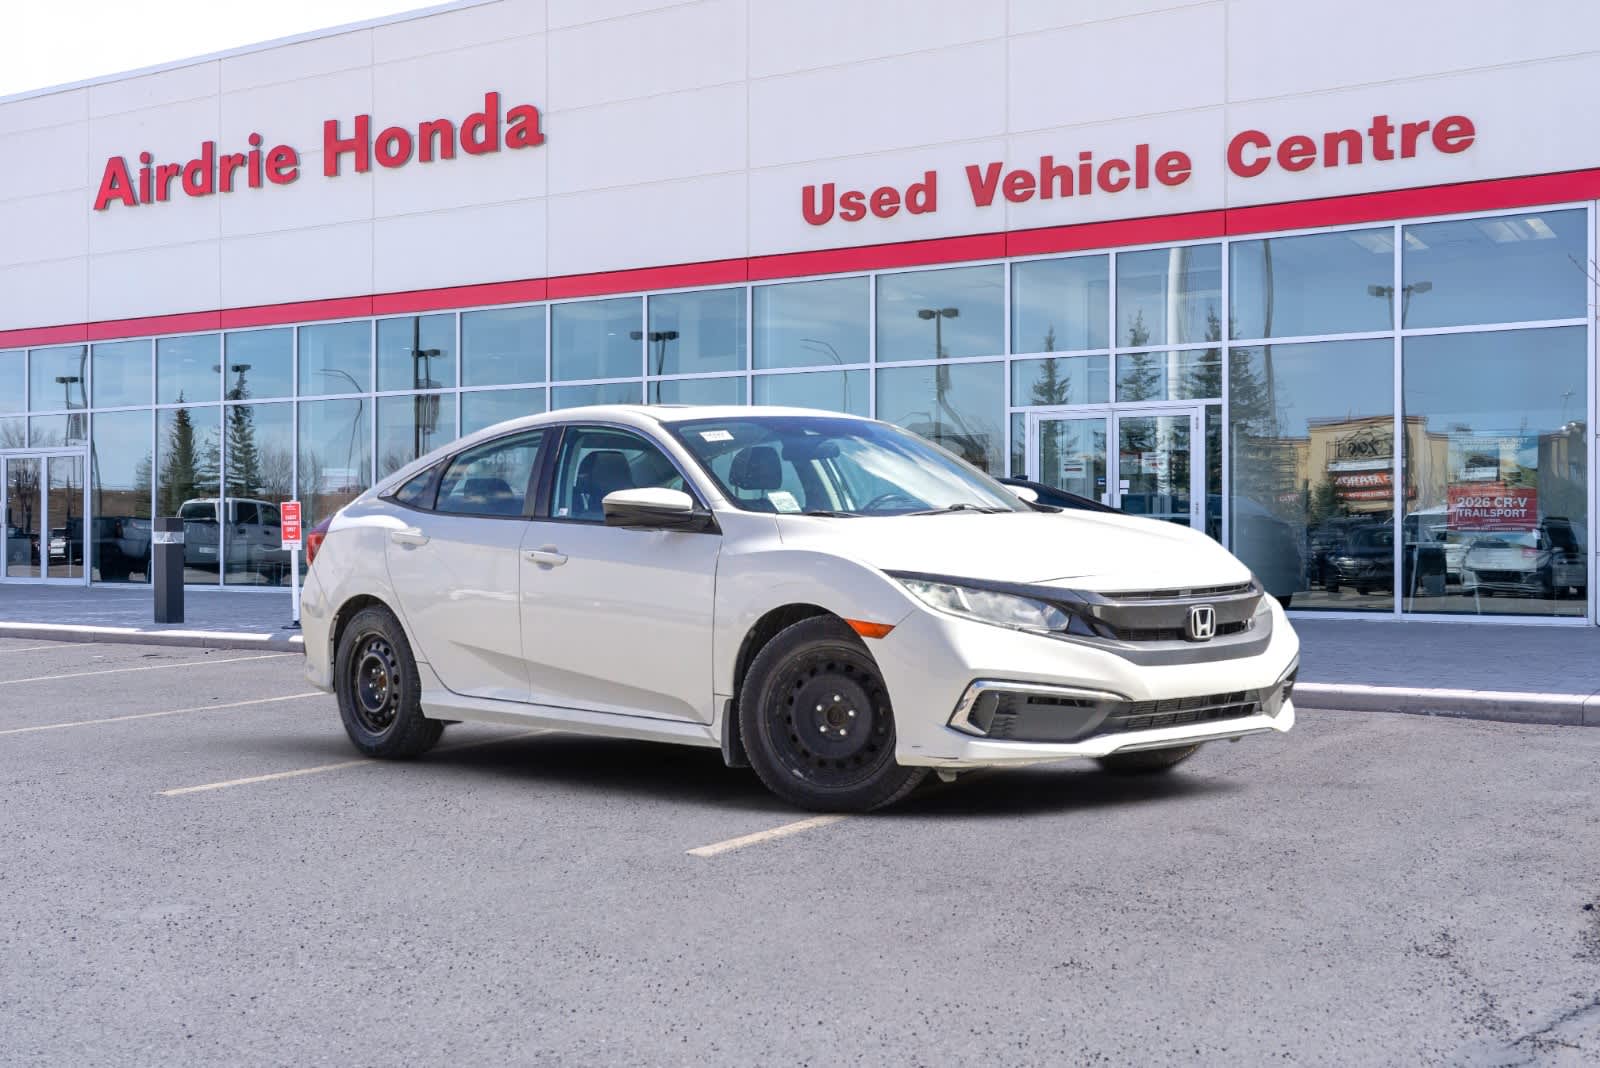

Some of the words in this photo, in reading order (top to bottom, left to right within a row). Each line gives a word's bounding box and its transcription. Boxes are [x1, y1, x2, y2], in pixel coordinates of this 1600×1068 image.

[95, 133, 298, 210] Airdrie
[323, 91, 546, 177] Honda
[802, 171, 938, 226] Used
[966, 144, 1192, 207] Vehicle
[1228, 115, 1476, 177] Centre
[1457, 496, 1490, 508] 2026
[1494, 496, 1528, 508] CR-V
[1458, 508, 1528, 518] TRAILSPORT
